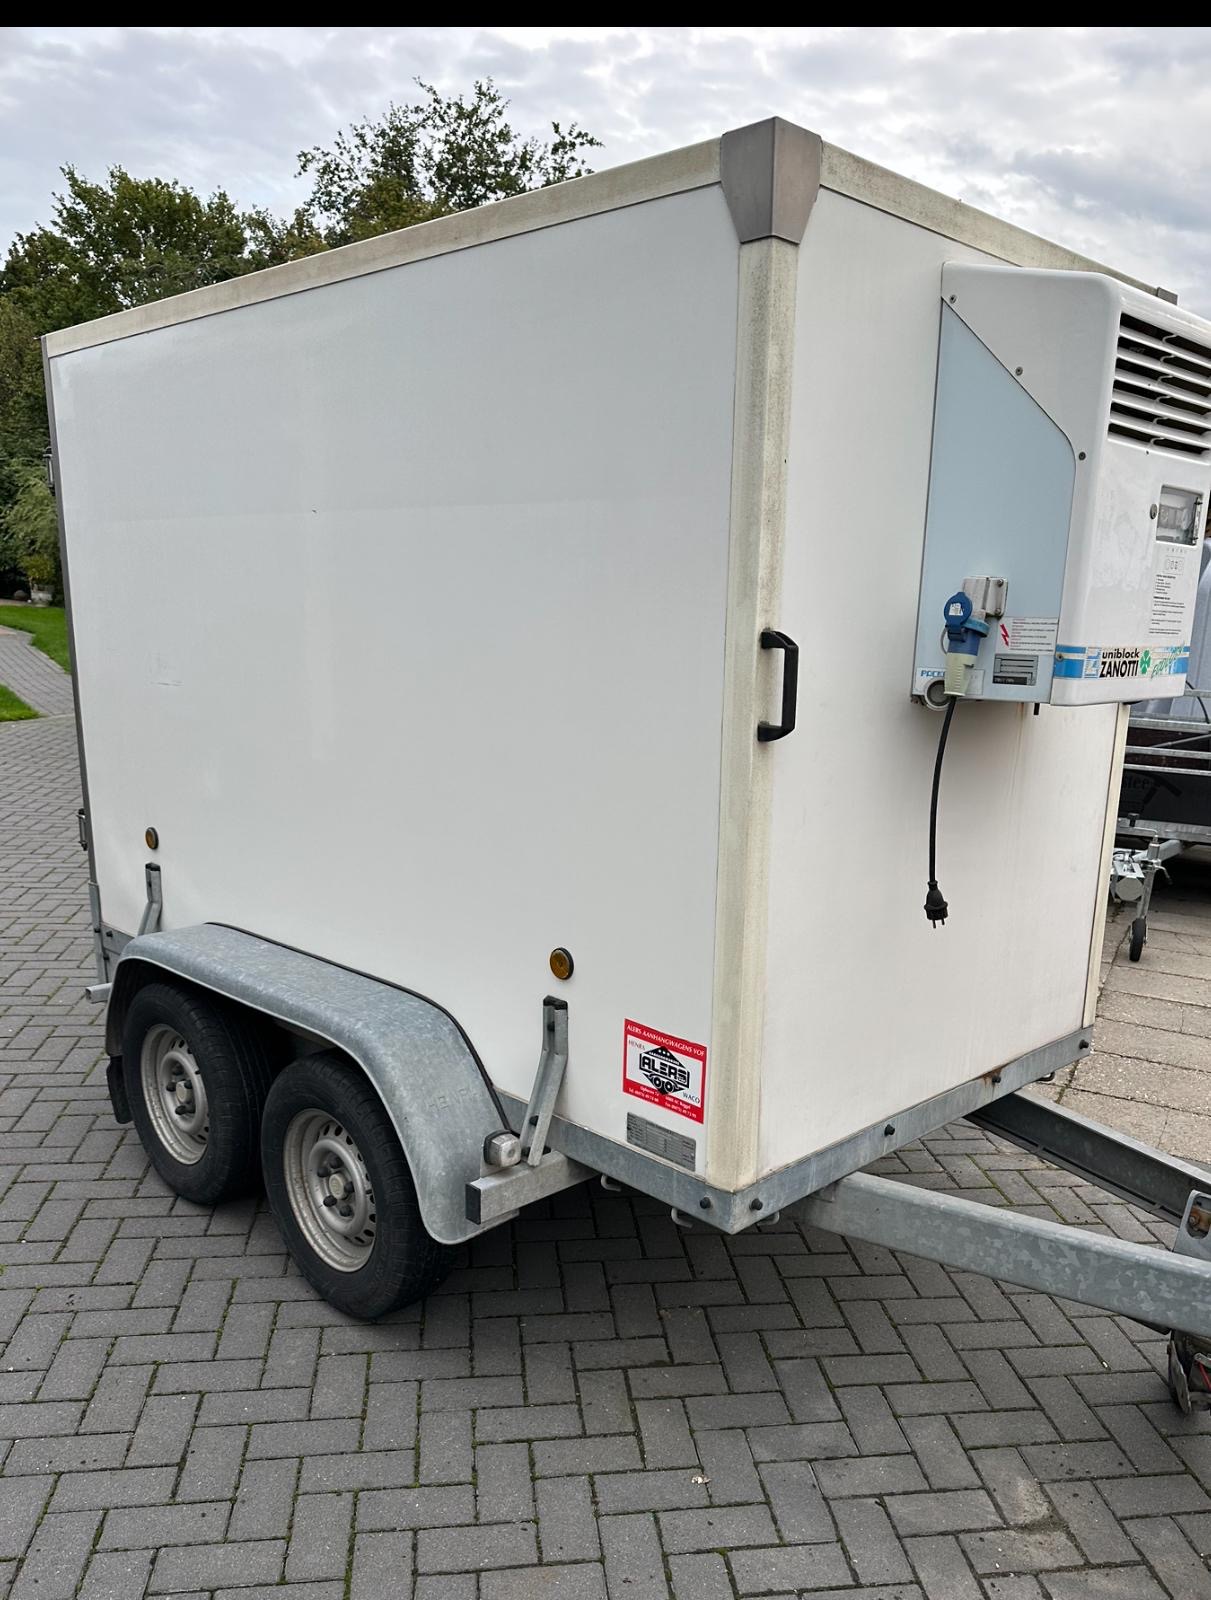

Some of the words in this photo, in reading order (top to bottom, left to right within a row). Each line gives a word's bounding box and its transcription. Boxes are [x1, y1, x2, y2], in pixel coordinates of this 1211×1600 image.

[1102, 648, 1140, 659] uniblock
[1100, 660, 1139, 678] ZANOTTI
[627, 1024, 642, 1034] ALERS
[642, 1030, 693, 1052] AANHANGWAGENS
[693, 1048, 705, 1056] VOF
[642, 1056, 687, 1083] ALERS
[683, 1092, 701, 1104] WACO
